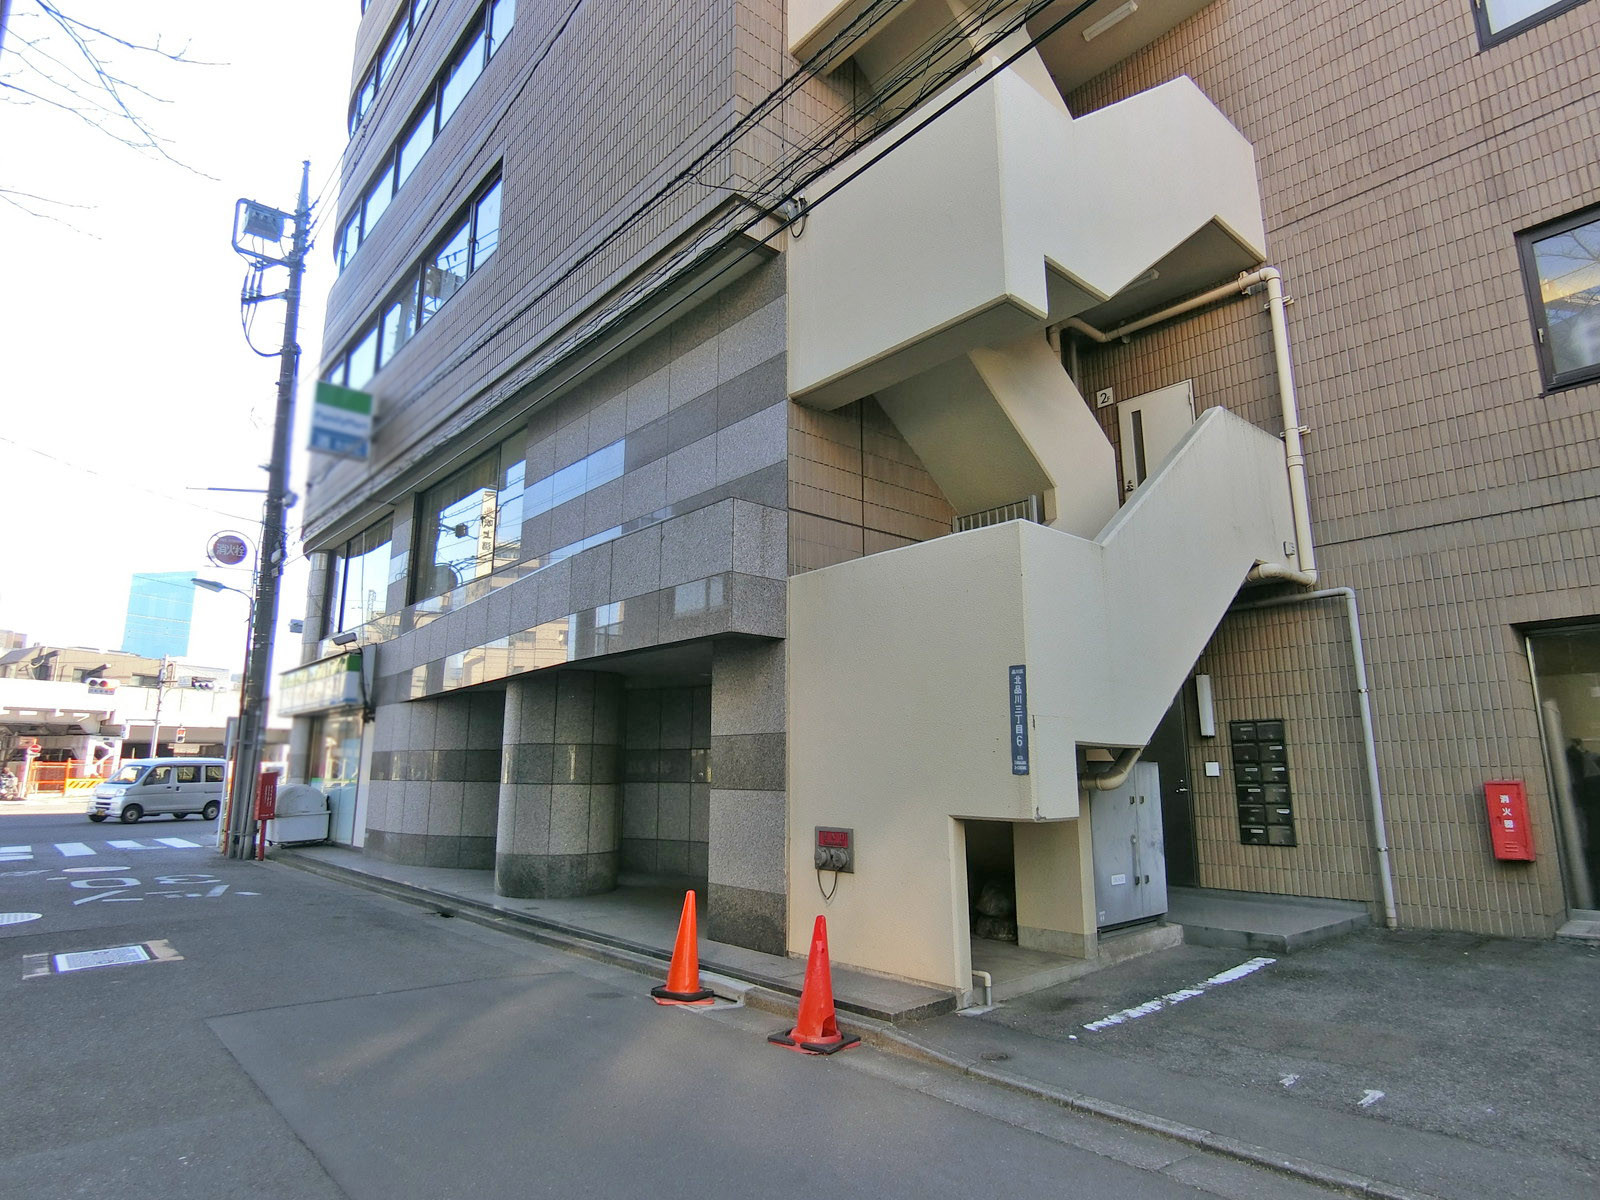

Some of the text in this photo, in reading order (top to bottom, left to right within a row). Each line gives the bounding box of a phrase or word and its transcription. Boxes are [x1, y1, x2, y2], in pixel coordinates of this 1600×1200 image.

[216, 543, 245, 557] 消火栓
[1013, 675, 1023, 747] 北品川三丁目6
